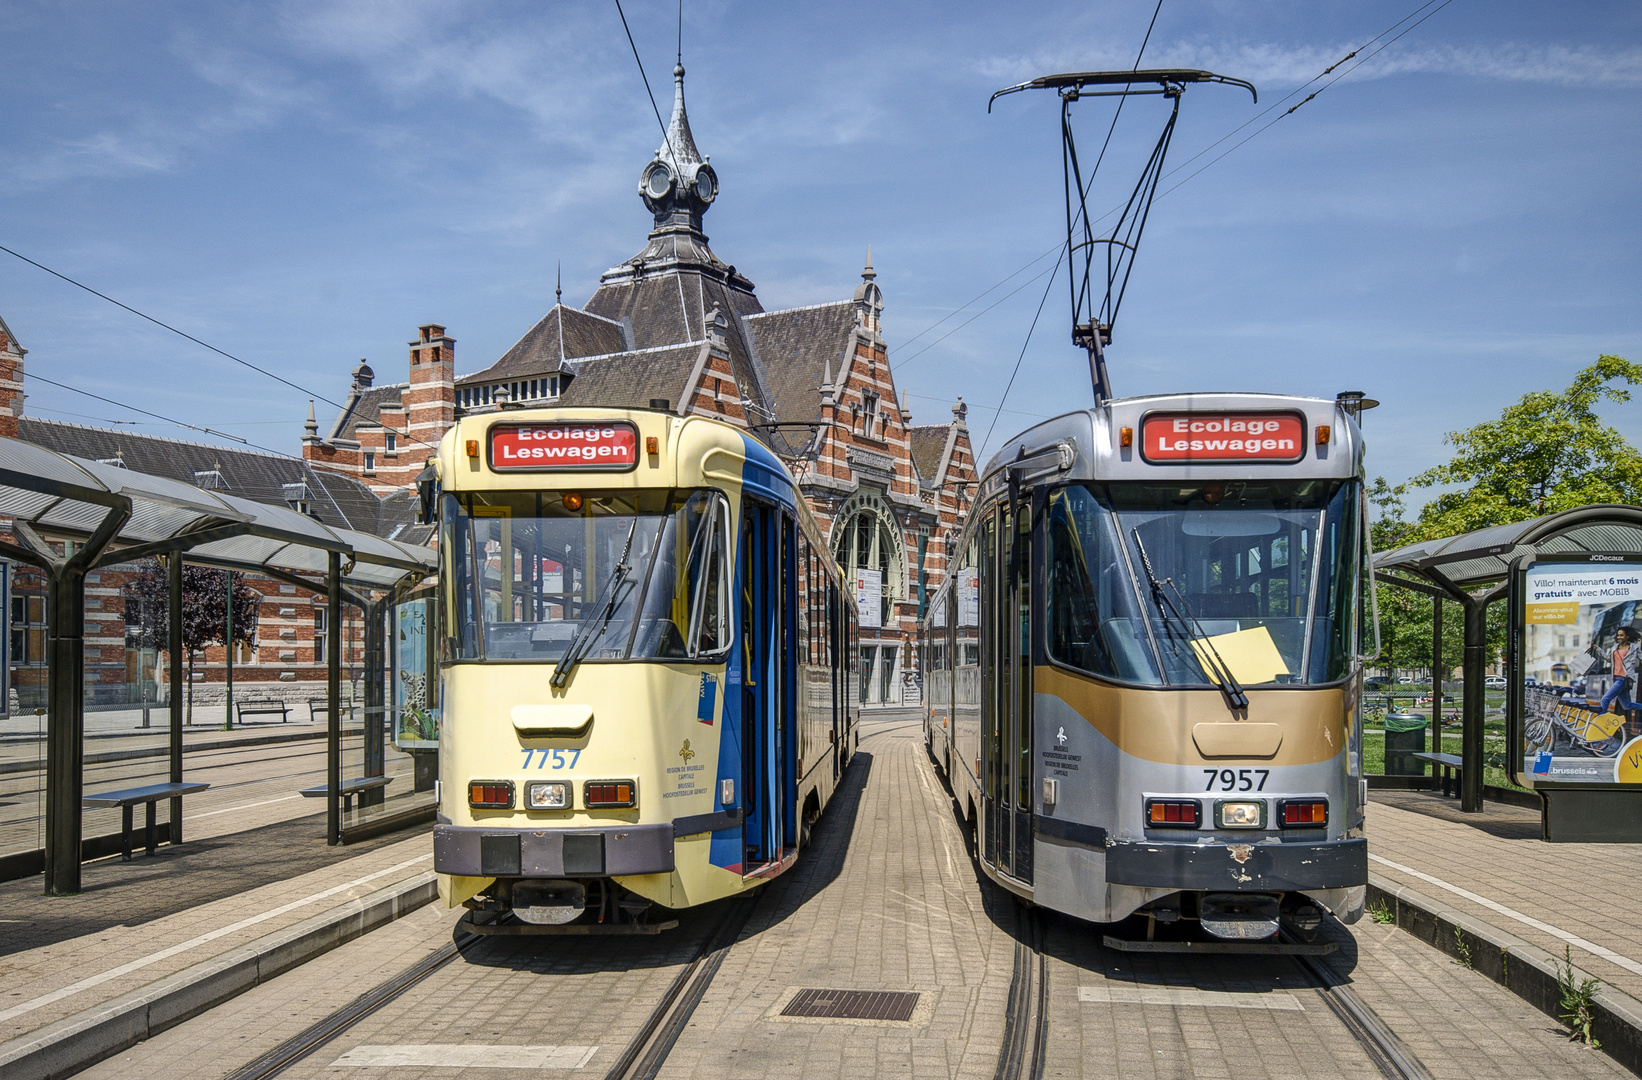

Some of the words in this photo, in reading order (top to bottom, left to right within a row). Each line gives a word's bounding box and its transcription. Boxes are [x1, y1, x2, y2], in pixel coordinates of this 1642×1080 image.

[517, 426, 616, 442] Ecolage
[1172, 418, 1280, 435] Ecolage
[503, 445, 628, 460] Leswagen
[1158, 436, 1294, 453] Leswagen
[1533, 579, 1556, 587] Villo!
[1558, 578, 1607, 587] maintenant
[1609, 577, 1615, 585] 6
[1617, 577, 1639, 585] mois
[1600, 588, 1630, 597] MOBIB
[705, 674, 717, 683] STIB
[520, 748, 582, 770] 7757
[1203, 769, 1270, 792] 7957
